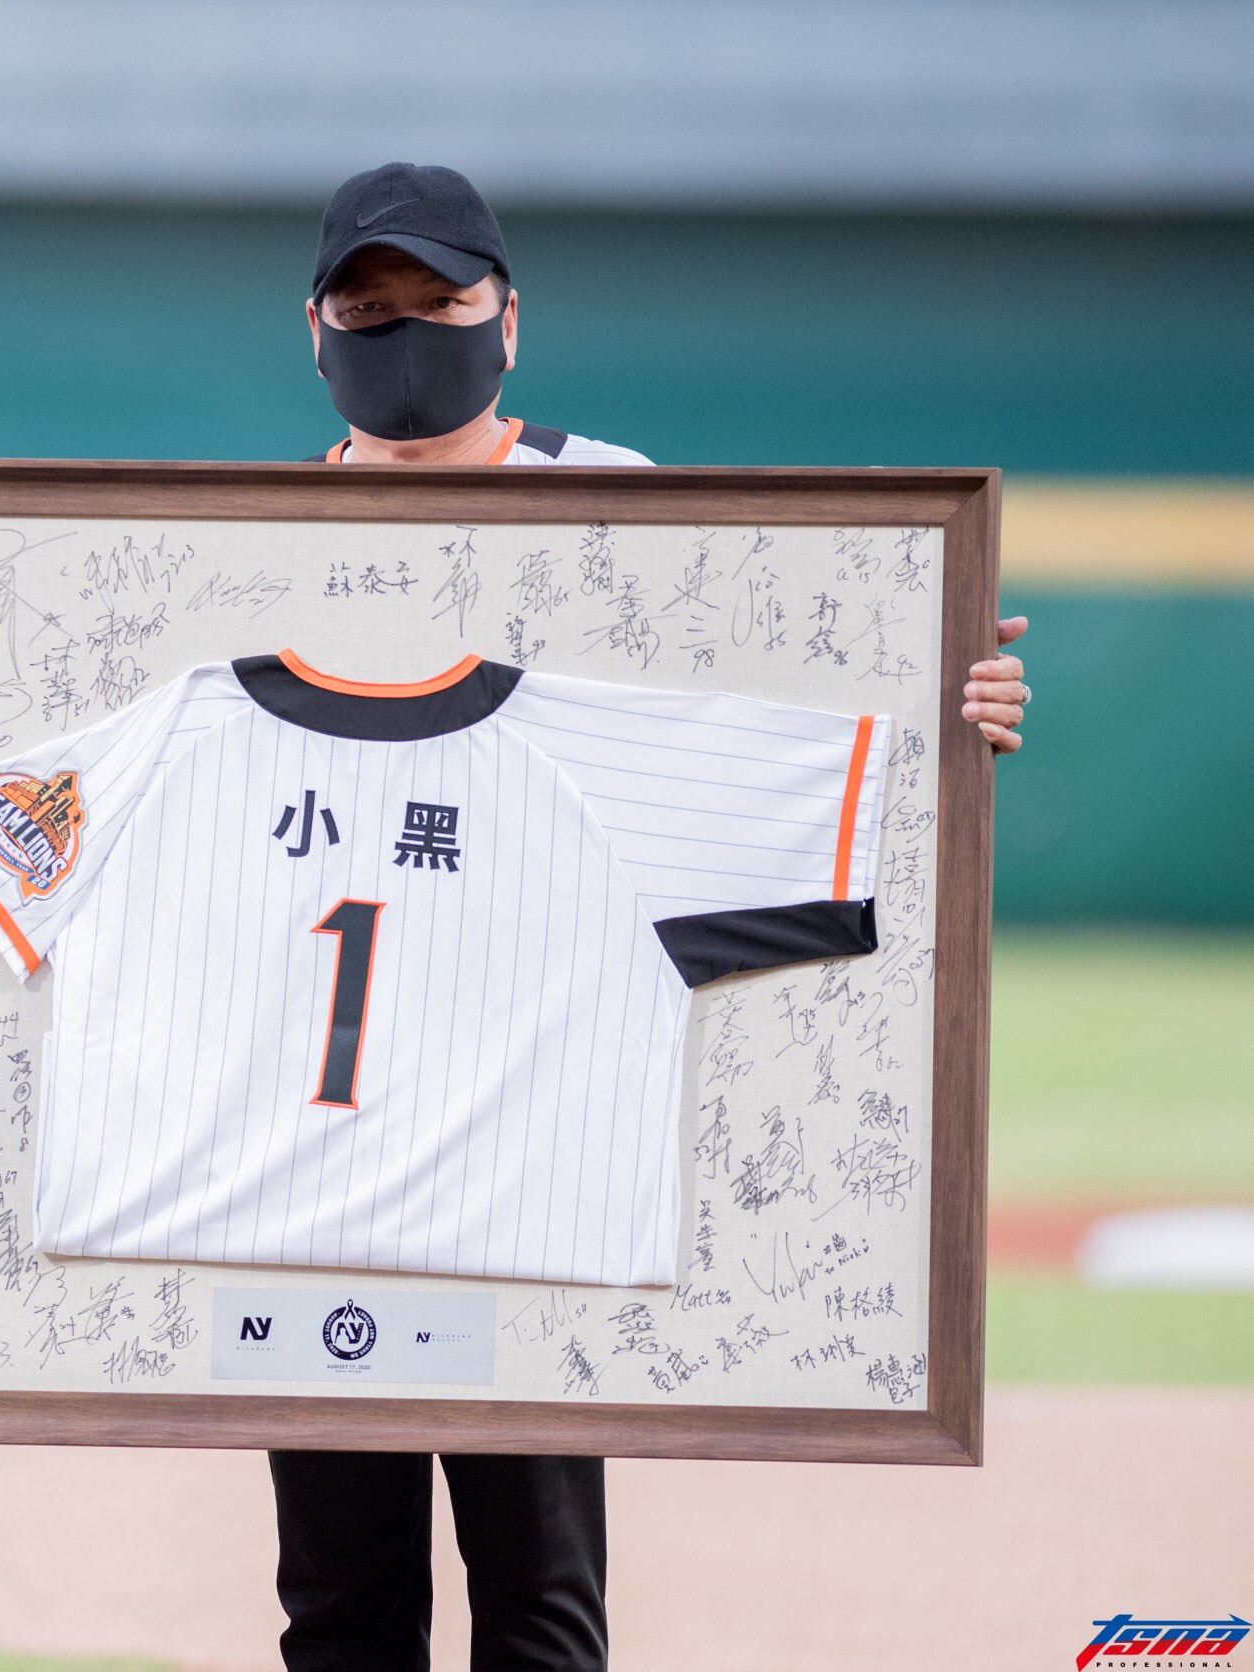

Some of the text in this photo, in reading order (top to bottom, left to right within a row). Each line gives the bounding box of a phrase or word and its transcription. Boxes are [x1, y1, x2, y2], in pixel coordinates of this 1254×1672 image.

[17, 822, 68, 882] LIONS
[272, 790, 461, 873] 小黑
[31, 876, 47, 888] 20
[309, 897, 387, 1111] 1
[670, 1284, 714, 1311] Matt
